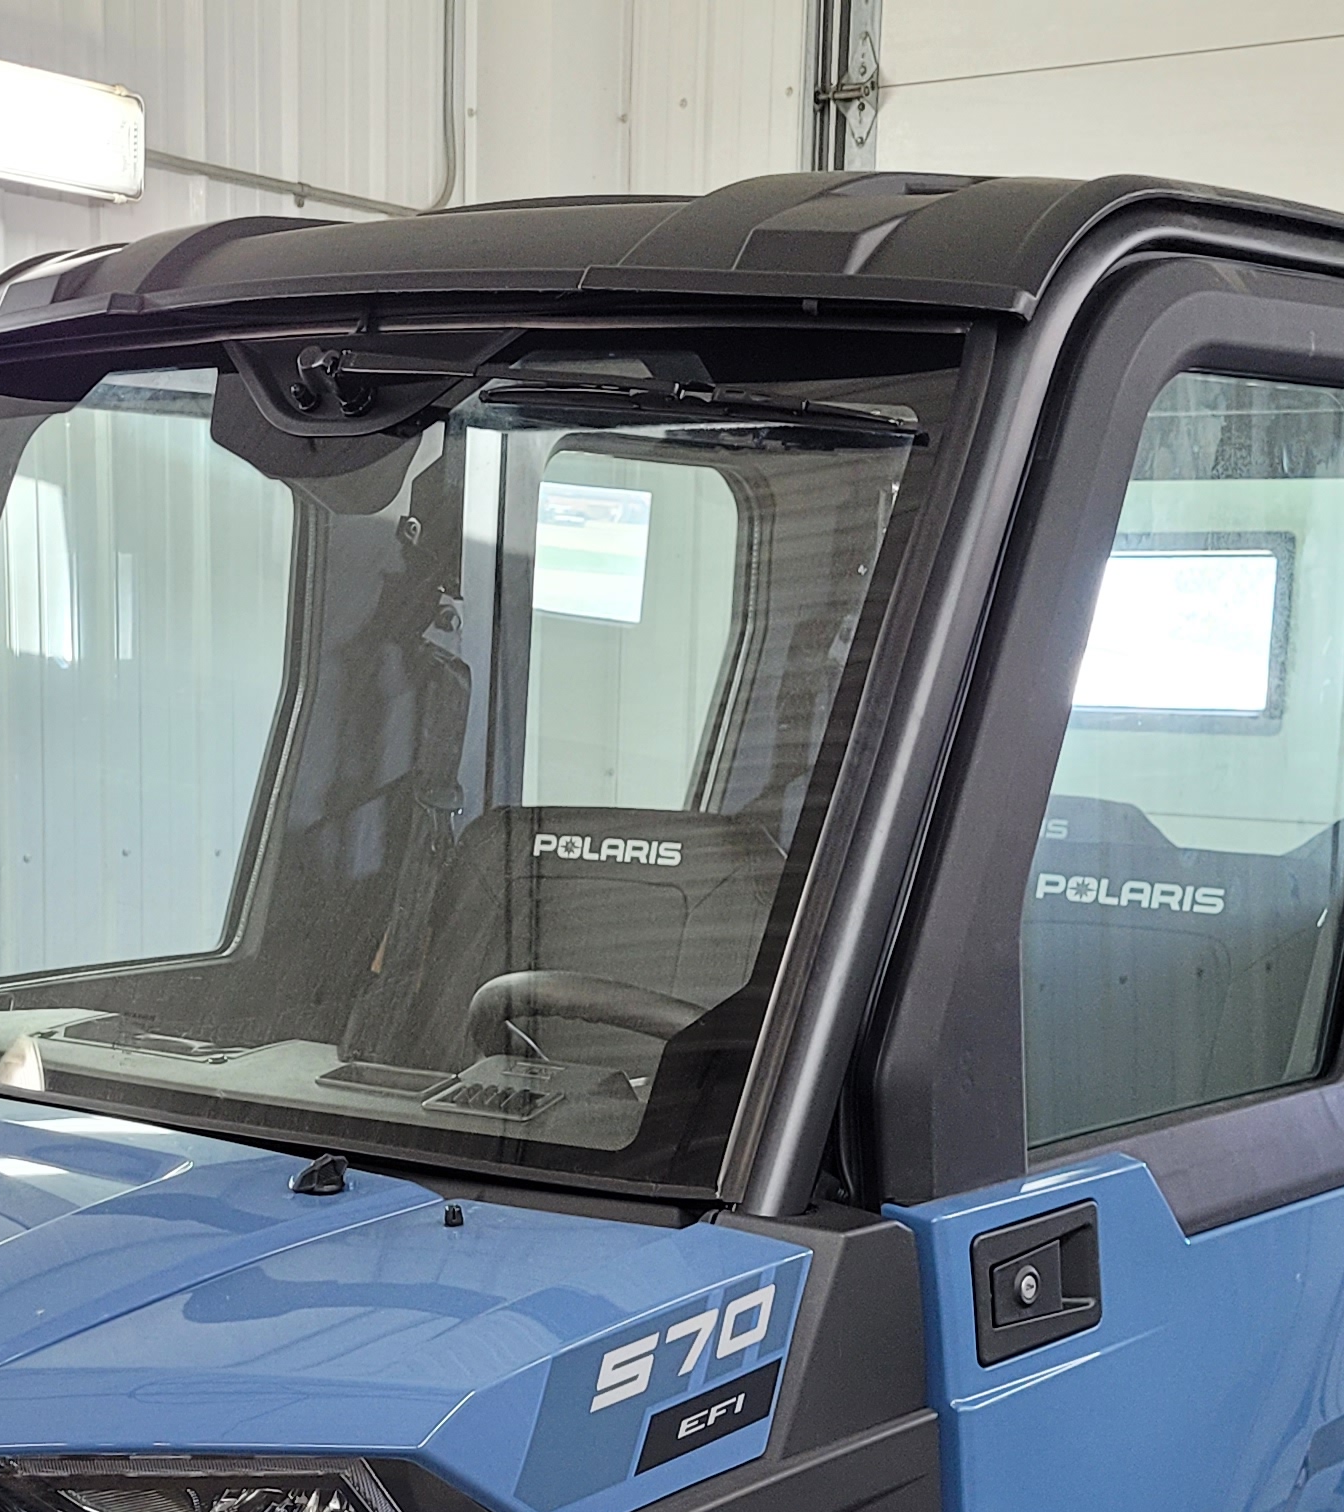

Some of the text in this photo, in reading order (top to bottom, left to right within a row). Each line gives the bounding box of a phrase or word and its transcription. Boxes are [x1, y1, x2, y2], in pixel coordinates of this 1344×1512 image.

[532, 833, 683, 867] POLARIS
[1035, 873, 1226, 915] POLARIS
[589, 1283, 776, 1414] 570
[676, 1392, 746, 1441] EFI
